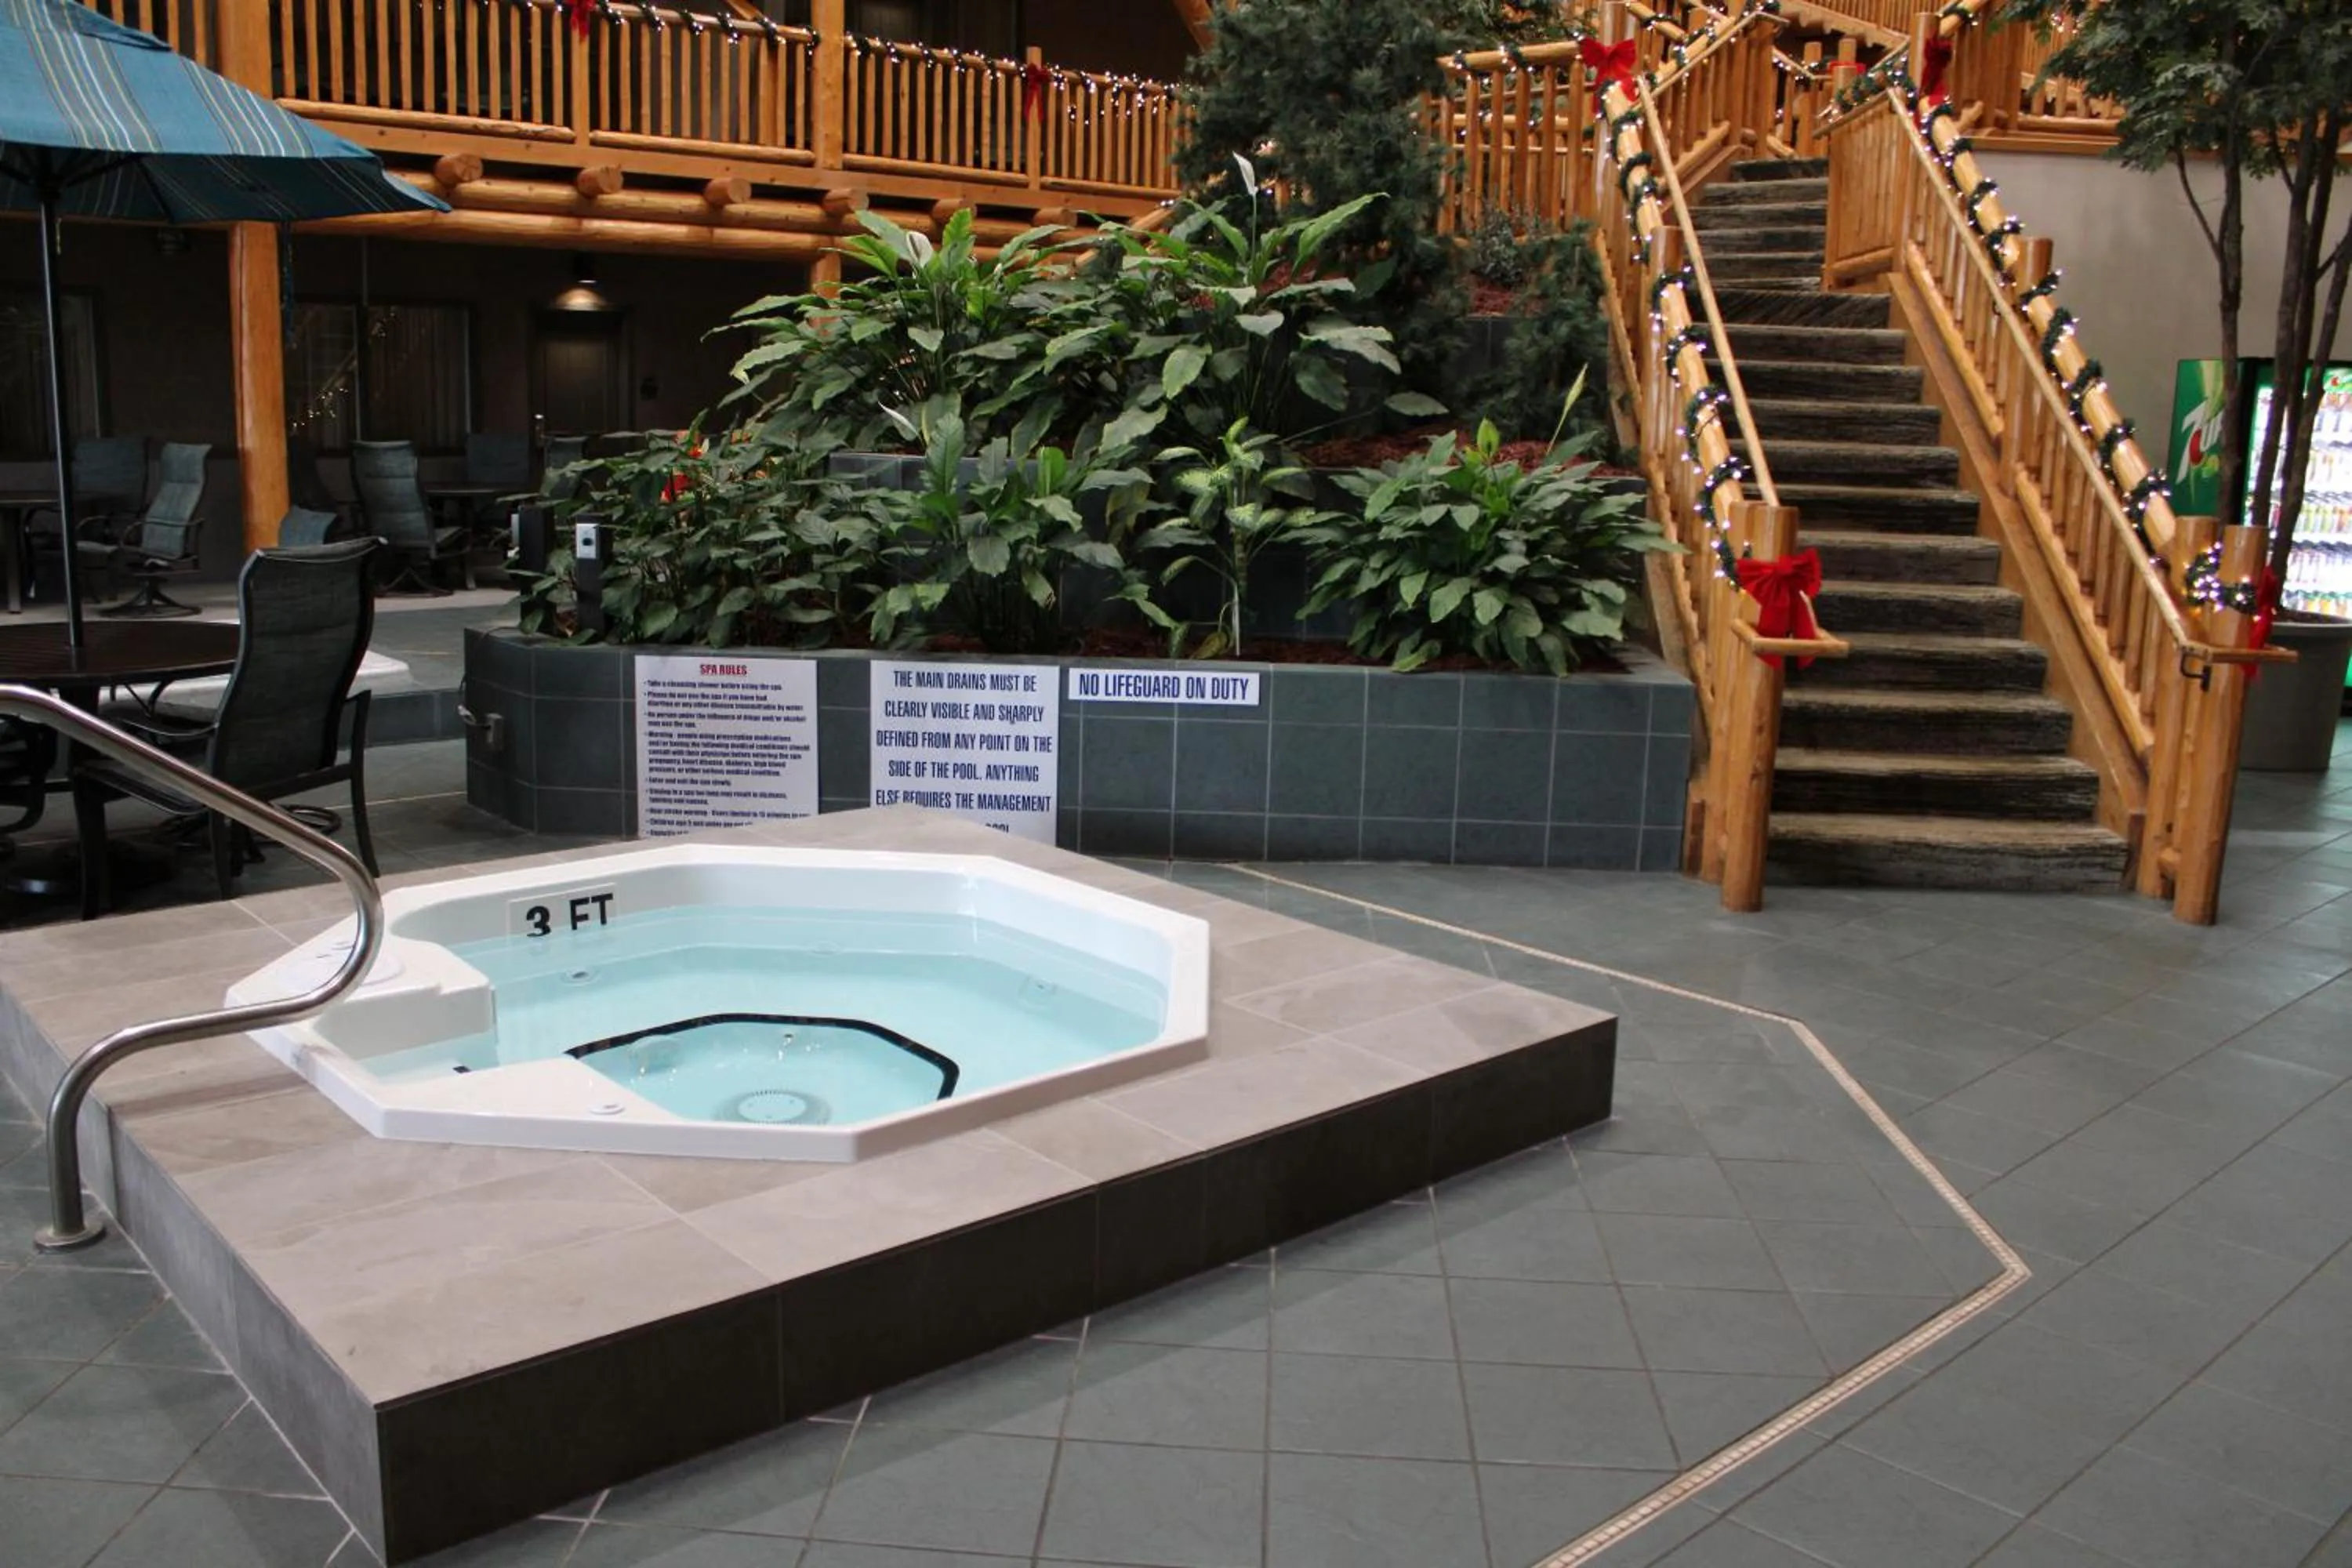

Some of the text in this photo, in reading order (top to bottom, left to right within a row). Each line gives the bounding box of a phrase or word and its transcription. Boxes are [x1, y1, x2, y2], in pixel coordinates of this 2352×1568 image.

[700, 665, 747, 675] SPA RULES
[894, 671, 1036, 691] THE MAIN DRAINS MUST BE
[1080, 673, 1249, 700] NO LIFEGUARD ON DUTY
[885, 701, 1044, 723] CLEARLY VISIBLE AND SHARPLY
[877, 731, 1052, 752] DEFINED FROM ANY POINT ON THE
[888, 760, 1039, 782] SIDE OF THE POOL. ANYTHING
[876, 789, 1051, 811] ELSE REQUIRES THE MANAGEMENT
[526, 893, 613, 937] 3 FT
